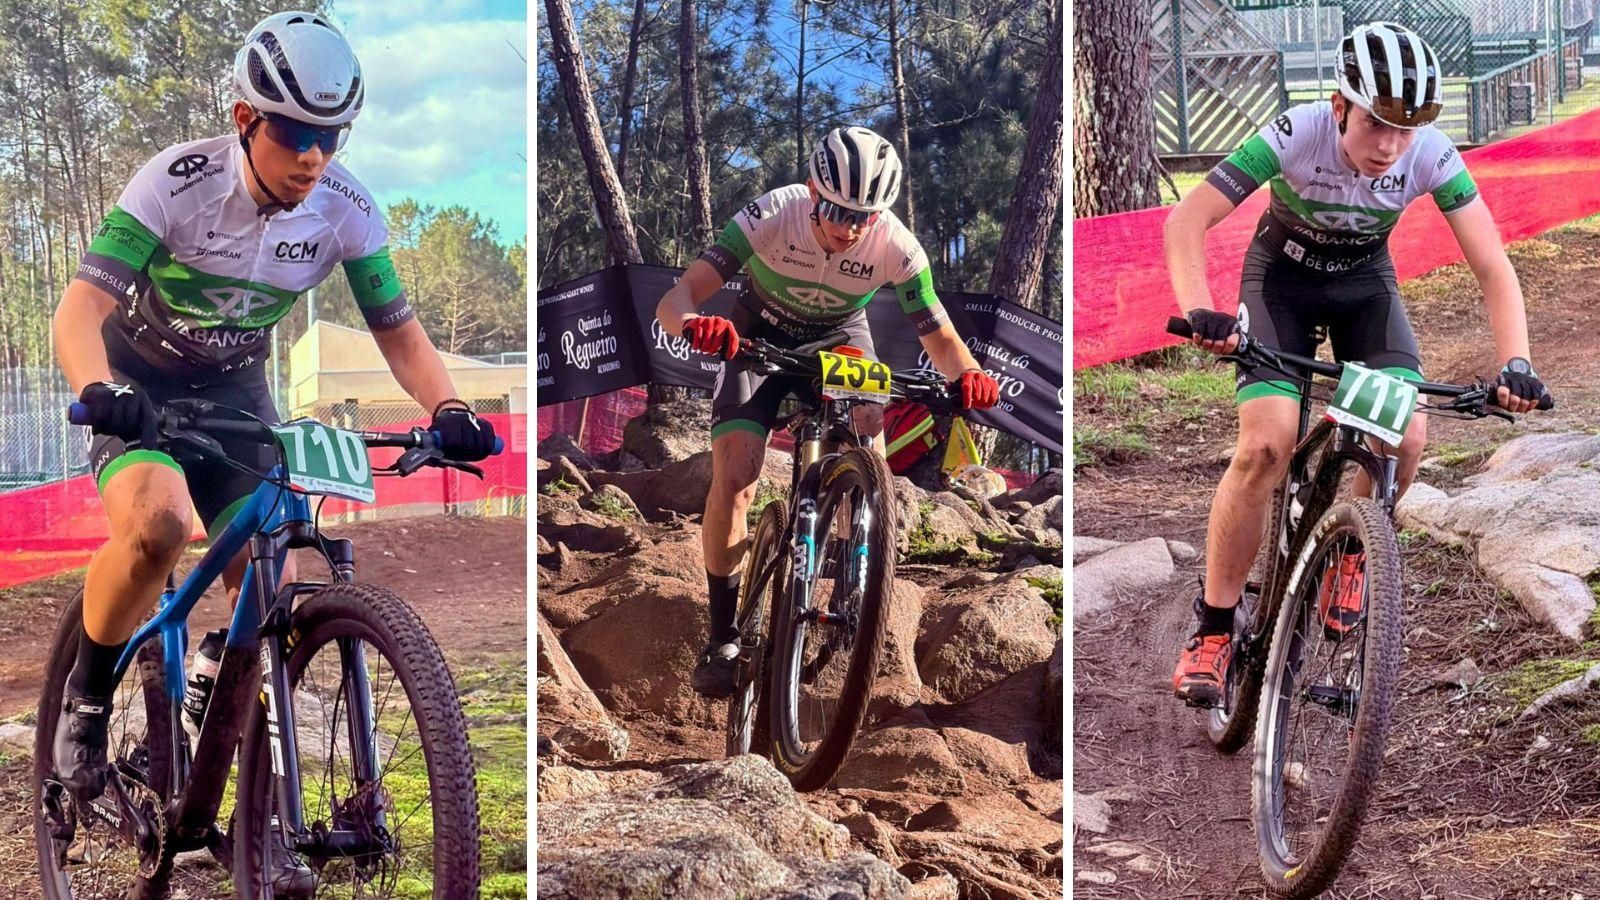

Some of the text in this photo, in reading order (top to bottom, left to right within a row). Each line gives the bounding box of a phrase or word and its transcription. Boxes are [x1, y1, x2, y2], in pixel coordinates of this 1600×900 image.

[170, 165, 225, 199] Academia Postal
[1370, 174, 1405, 191] CCM
[275, 241, 319, 260] CCM
[1305, 257, 1323, 271] DE
[79, 263, 127, 294] OTTOBOSLEY
[840, 259, 874, 277] CCM
[578, 309, 612, 336] Quinta do
[964, 303, 994, 313] SMALL
[995, 308, 1042, 334] PRODUCER
[561, 330, 617, 369] Regueiro
[965, 336, 1029, 369] Quinta do
[597, 360, 621, 374] ALVARINHO
[824, 353, 888, 390] 254
[1341, 362, 1414, 431] 711
[277, 425, 368, 485] 710
[793, 543, 807, 581] FOX
